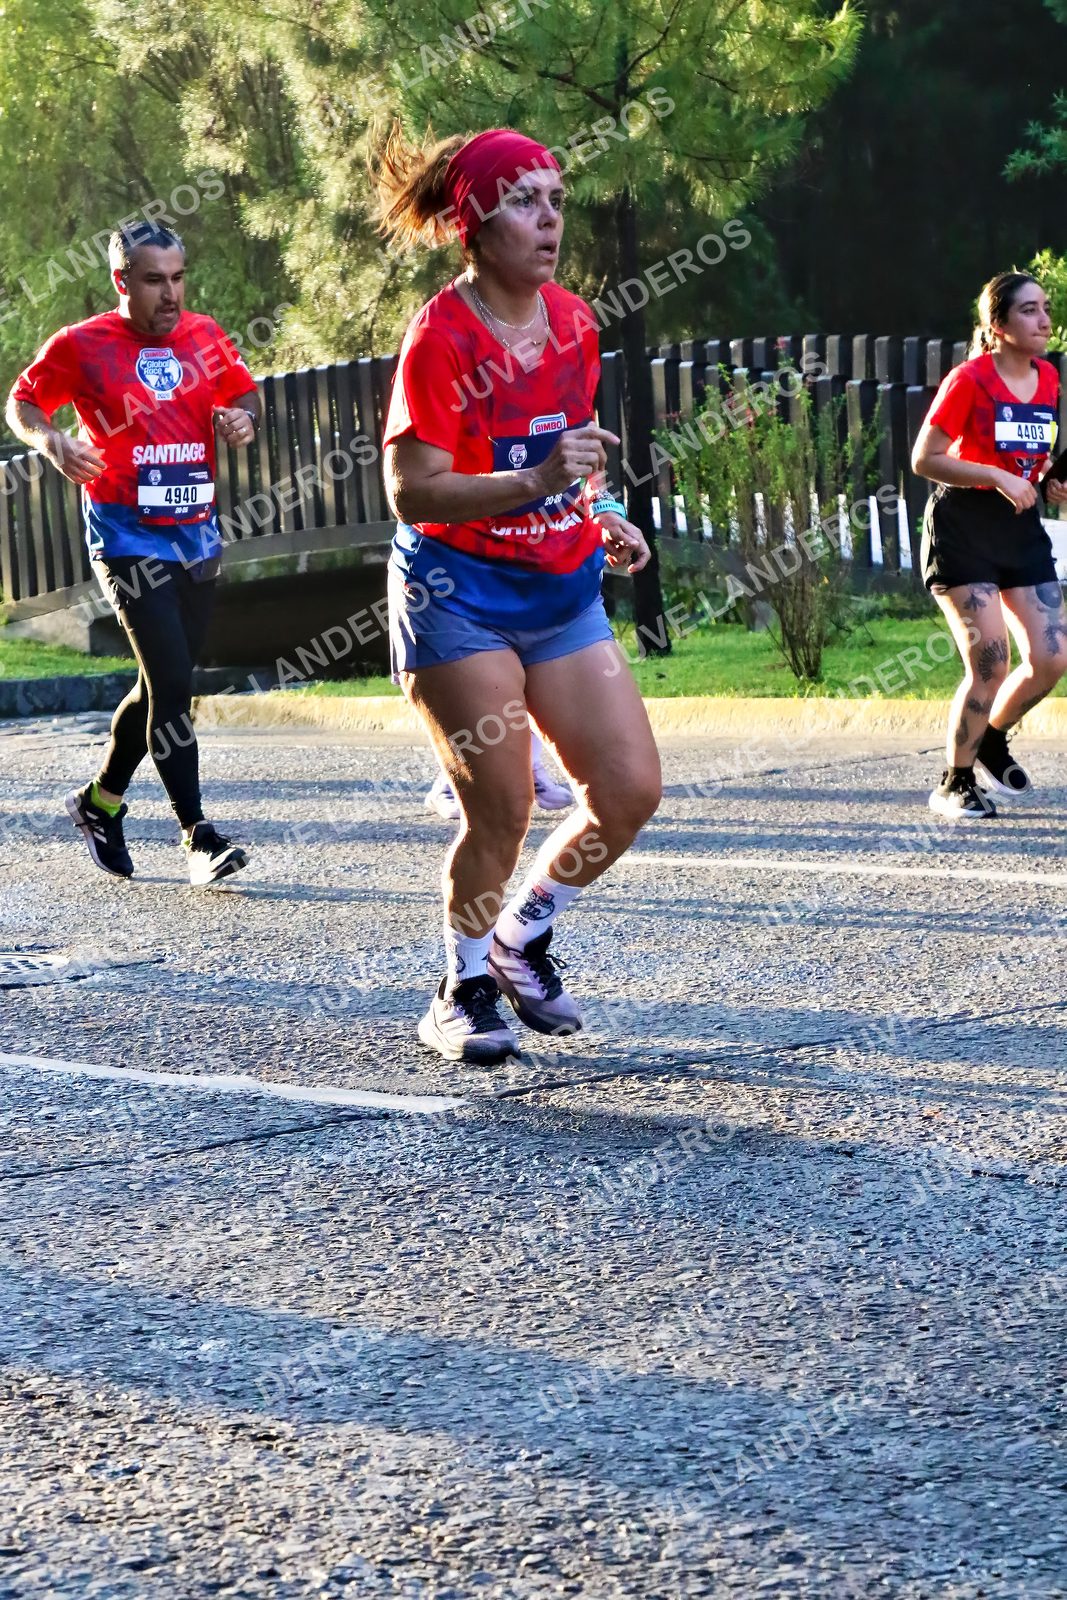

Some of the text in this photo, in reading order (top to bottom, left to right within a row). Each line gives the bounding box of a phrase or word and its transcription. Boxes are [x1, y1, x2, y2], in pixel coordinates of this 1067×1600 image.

[147, 360, 169, 369] Global
[144, 368, 163, 376] Race
[535, 421, 562, 433] BIMBO
[1017, 424, 1045, 441] 4403
[132, 443, 206, 465] SANTIAGO
[165, 486, 198, 505] 4940
